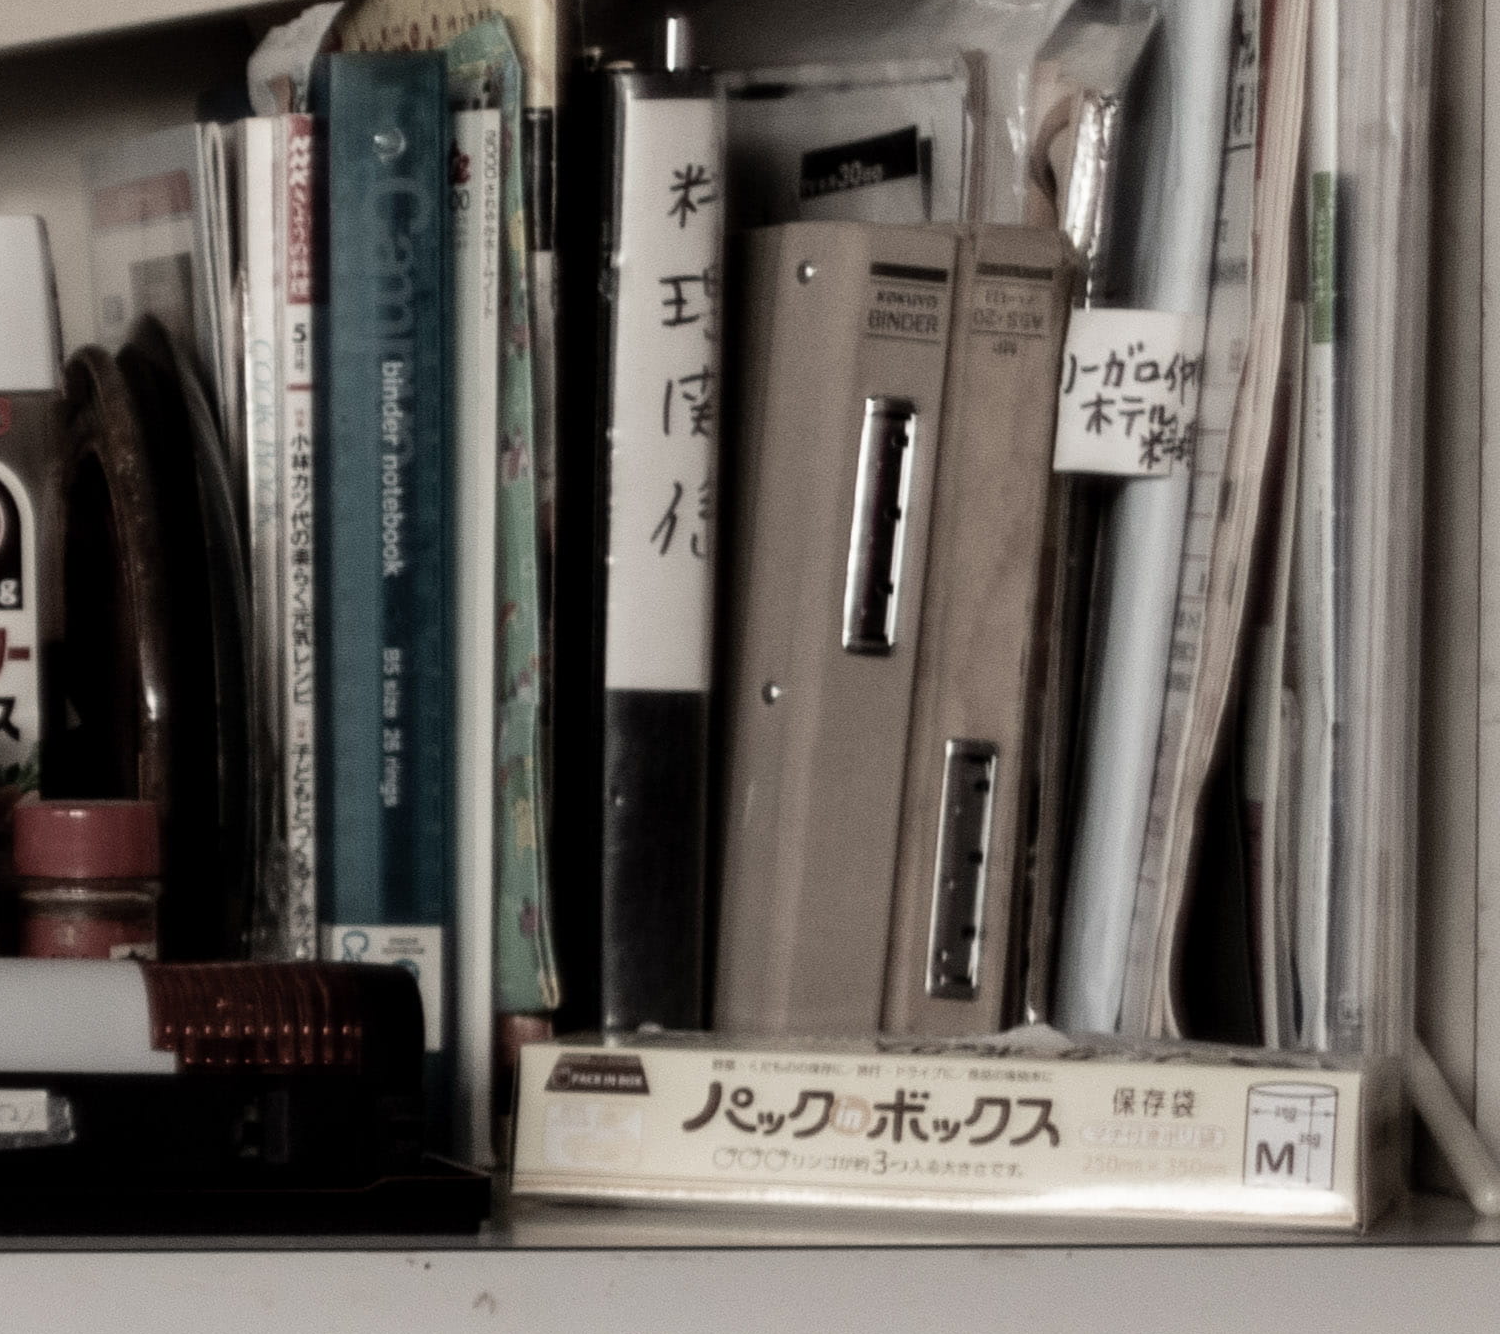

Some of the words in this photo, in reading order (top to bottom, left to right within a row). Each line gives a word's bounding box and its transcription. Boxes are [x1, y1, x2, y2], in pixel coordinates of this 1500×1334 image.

[867, 310, 940, 333] BINDER
[381, 360, 403, 447] binder
[381, 452, 404, 578] notebook
[1112, 1086, 1197, 1118] 保存袋
[1254, 1140, 1296, 1176] M
